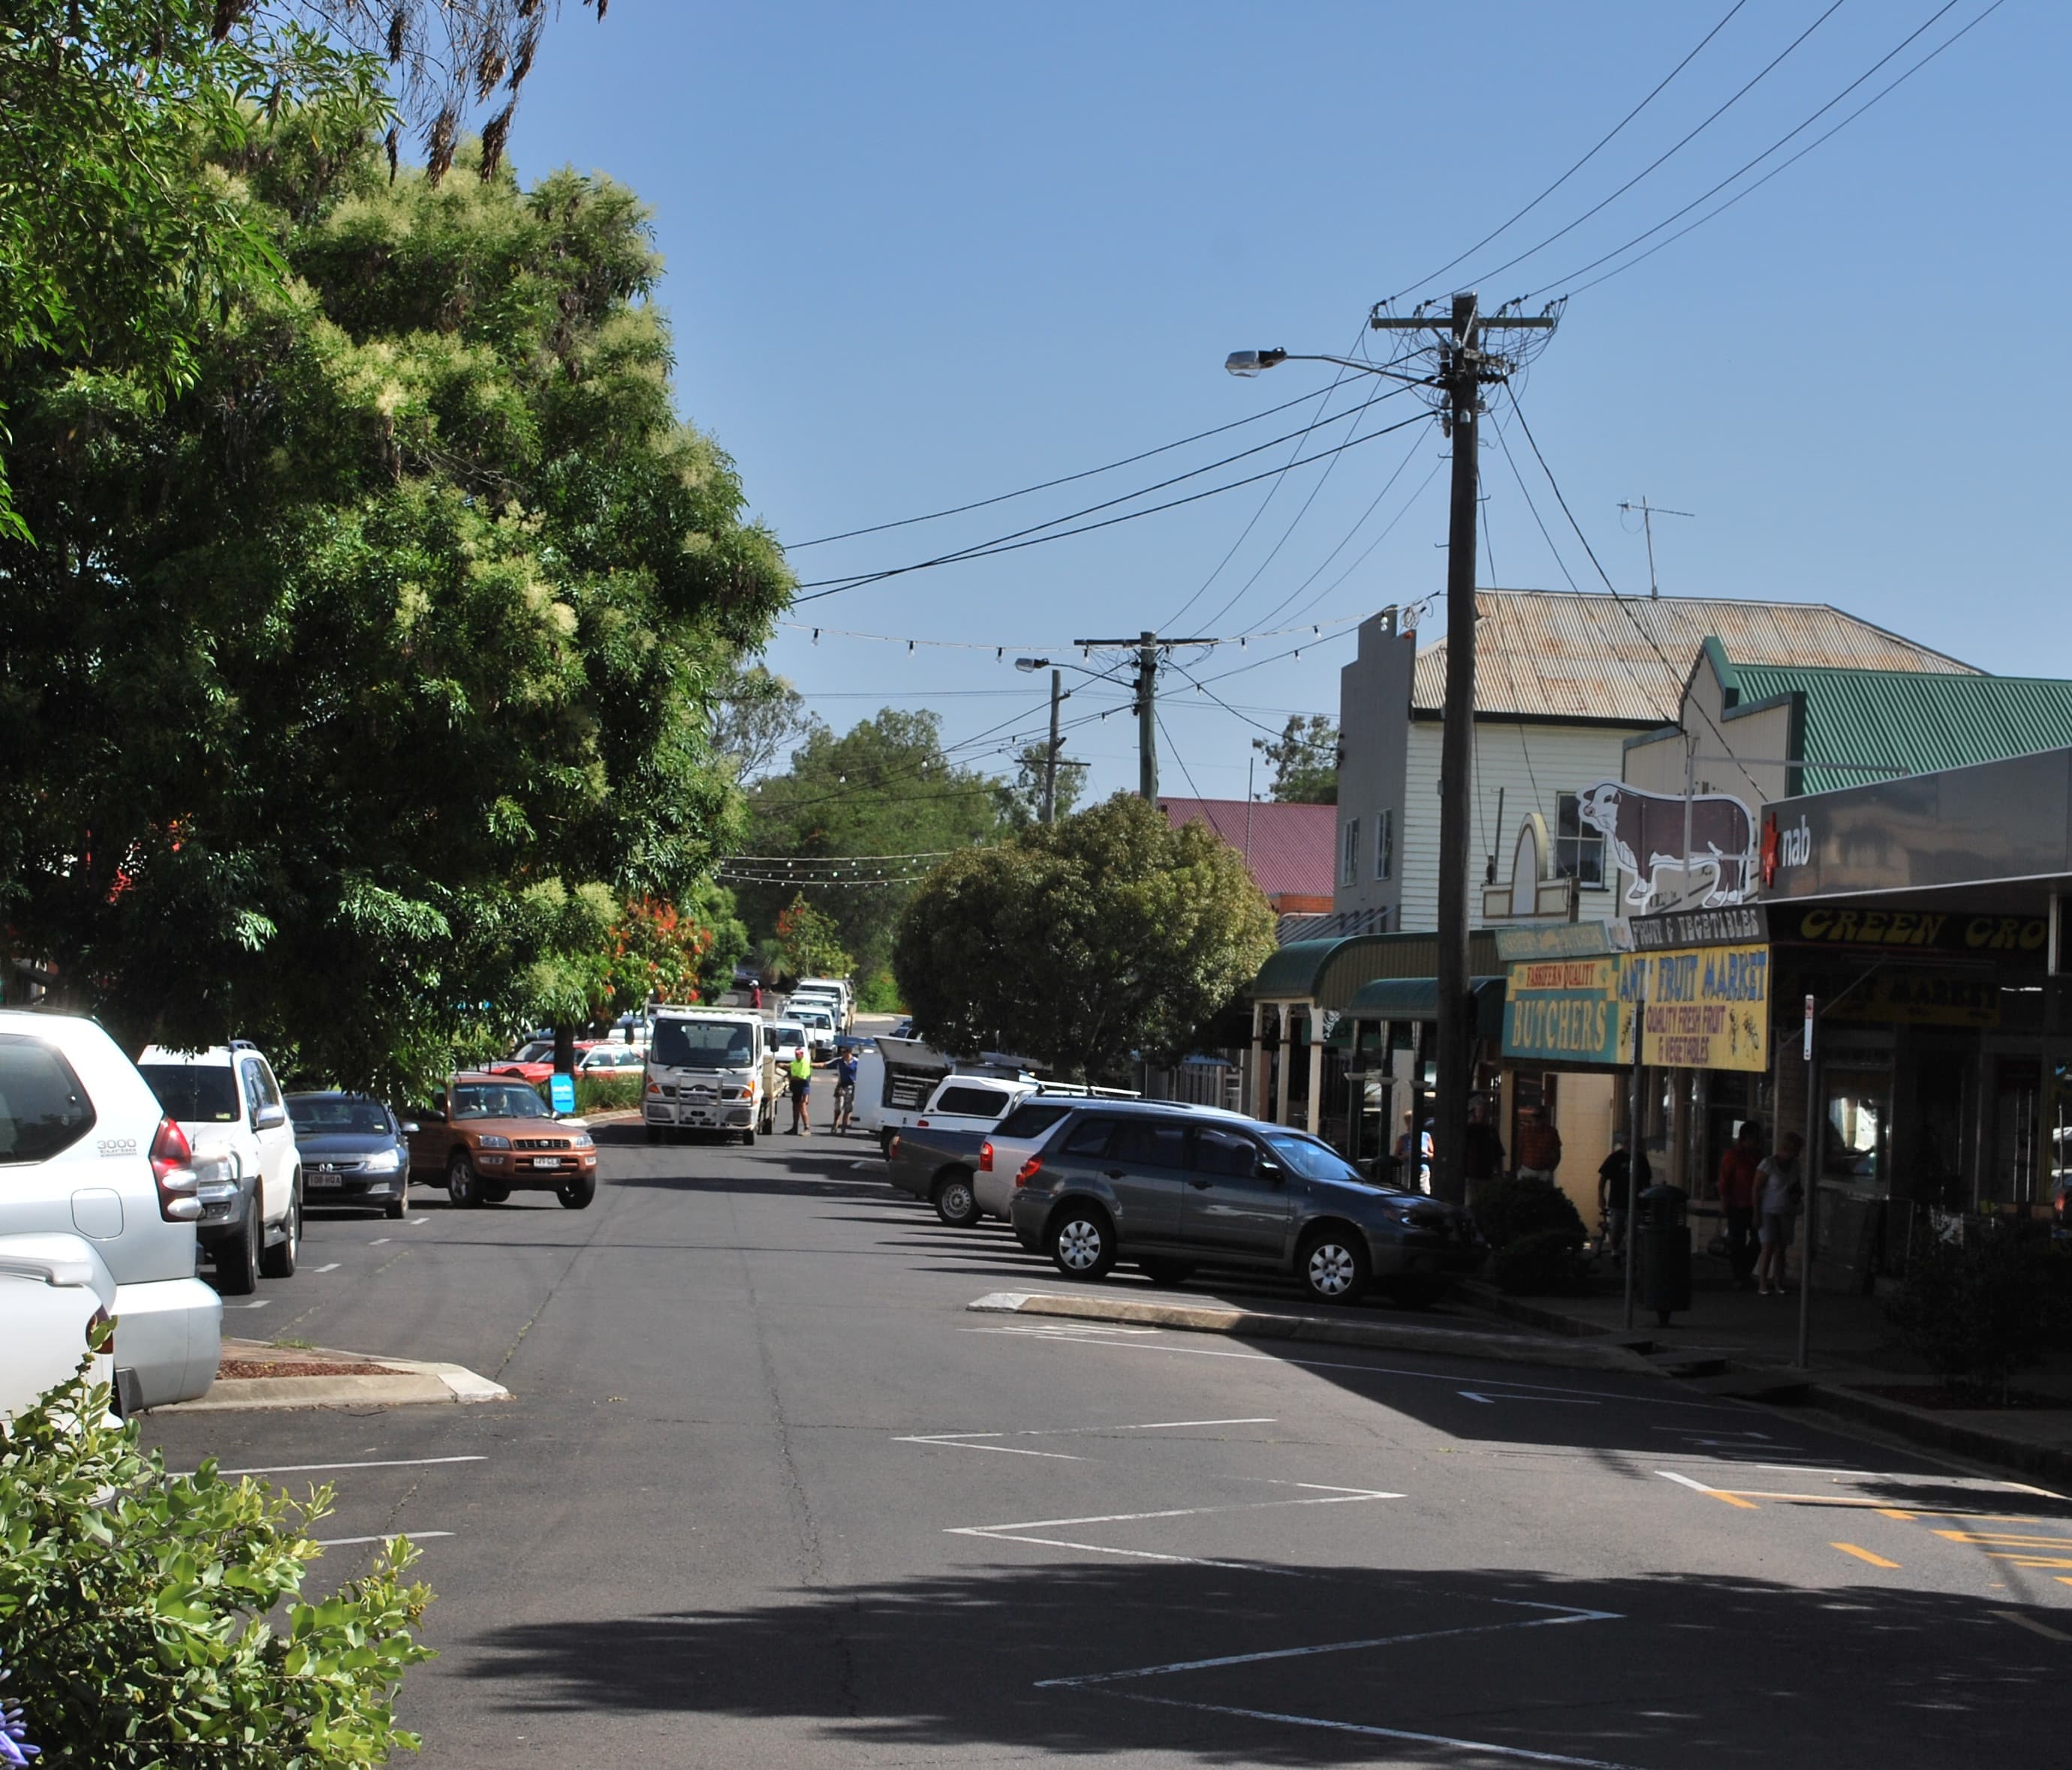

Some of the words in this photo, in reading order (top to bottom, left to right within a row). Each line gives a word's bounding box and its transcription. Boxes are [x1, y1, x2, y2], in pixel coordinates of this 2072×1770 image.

[1782, 814, 1810, 867] nab
[1632, 918, 1663, 945] FRUIT
[1678, 909, 1759, 941] VEGETABLES
[1801, 908, 1946, 947] GREEN
[1564, 964, 1595, 989] QUALITY
[1657, 956, 1698, 1002] FRUIT
[1701, 951, 1766, 1002] MARKET
[1512, 1000, 1606, 1051] BUTCHERS
[1646, 1006, 1677, 1033] QUALITY
[1678, 1006, 1702, 1033] FRESH
[1703, 1005, 1726, 1033] FRUIT
[1665, 1037, 1709, 1064] VEGETABLES
[97, 1139, 137, 1149] 3000
